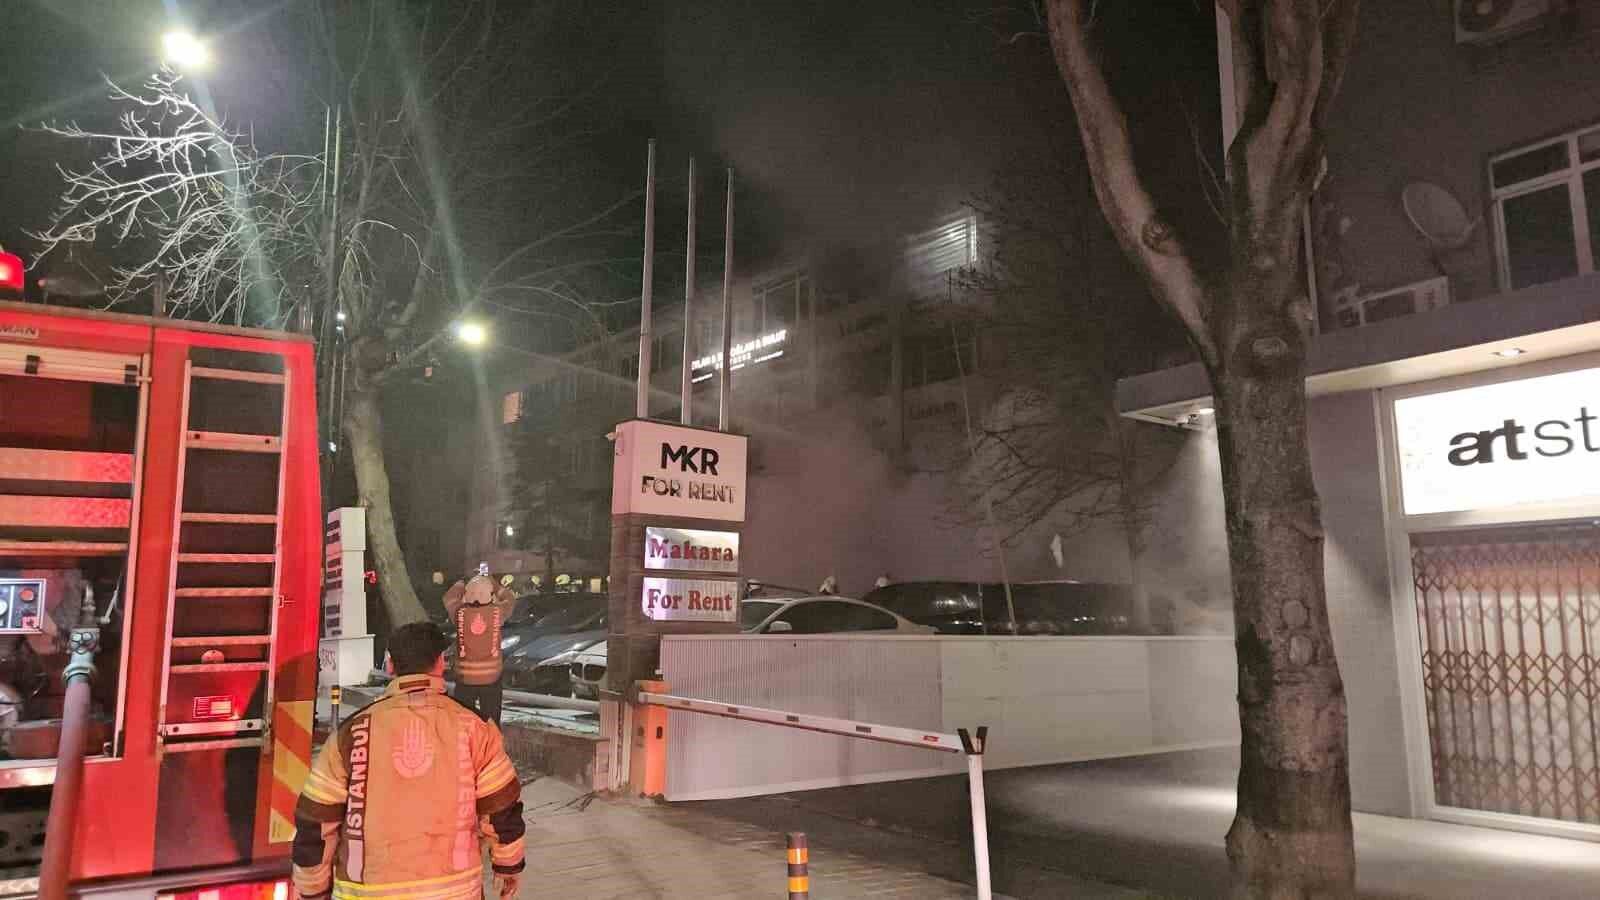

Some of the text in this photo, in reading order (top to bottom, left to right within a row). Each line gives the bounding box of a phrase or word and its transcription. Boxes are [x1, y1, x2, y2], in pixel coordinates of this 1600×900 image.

[661, 442, 719, 476] MKR
[642, 476, 736, 504] FOR RENT
[649, 538, 733, 562] Makara
[648, 588, 732, 611] For Rent
